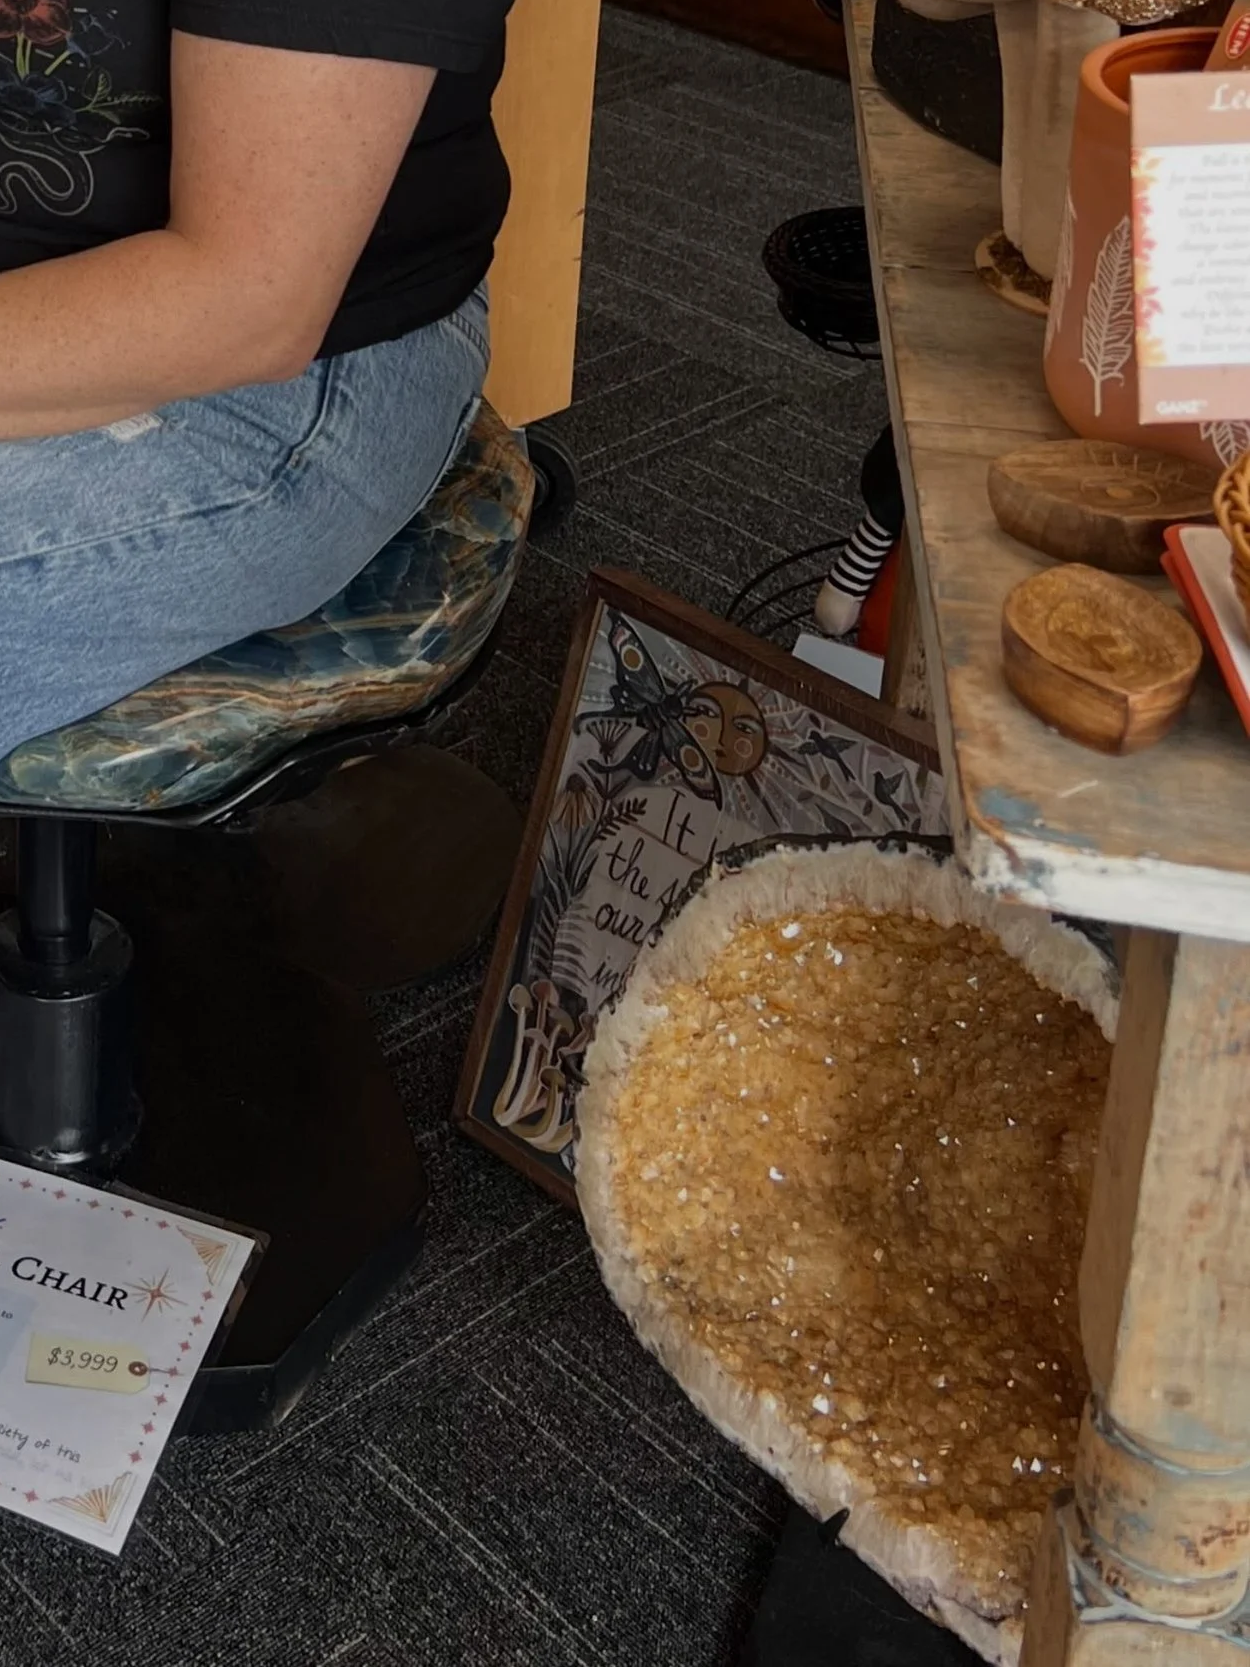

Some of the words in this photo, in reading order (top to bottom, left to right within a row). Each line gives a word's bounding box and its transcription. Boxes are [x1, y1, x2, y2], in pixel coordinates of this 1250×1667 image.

[663, 789, 695, 856] It
[606, 837, 650, 900] the
[11, 1256, 129, 1311] CHAIR
[0, 1309, 14, 1321] to
[47, 1346, 119, 1374] $3,999
[34, 1438, 52, 1450] of
[56, 1444, 82, 1463] this
